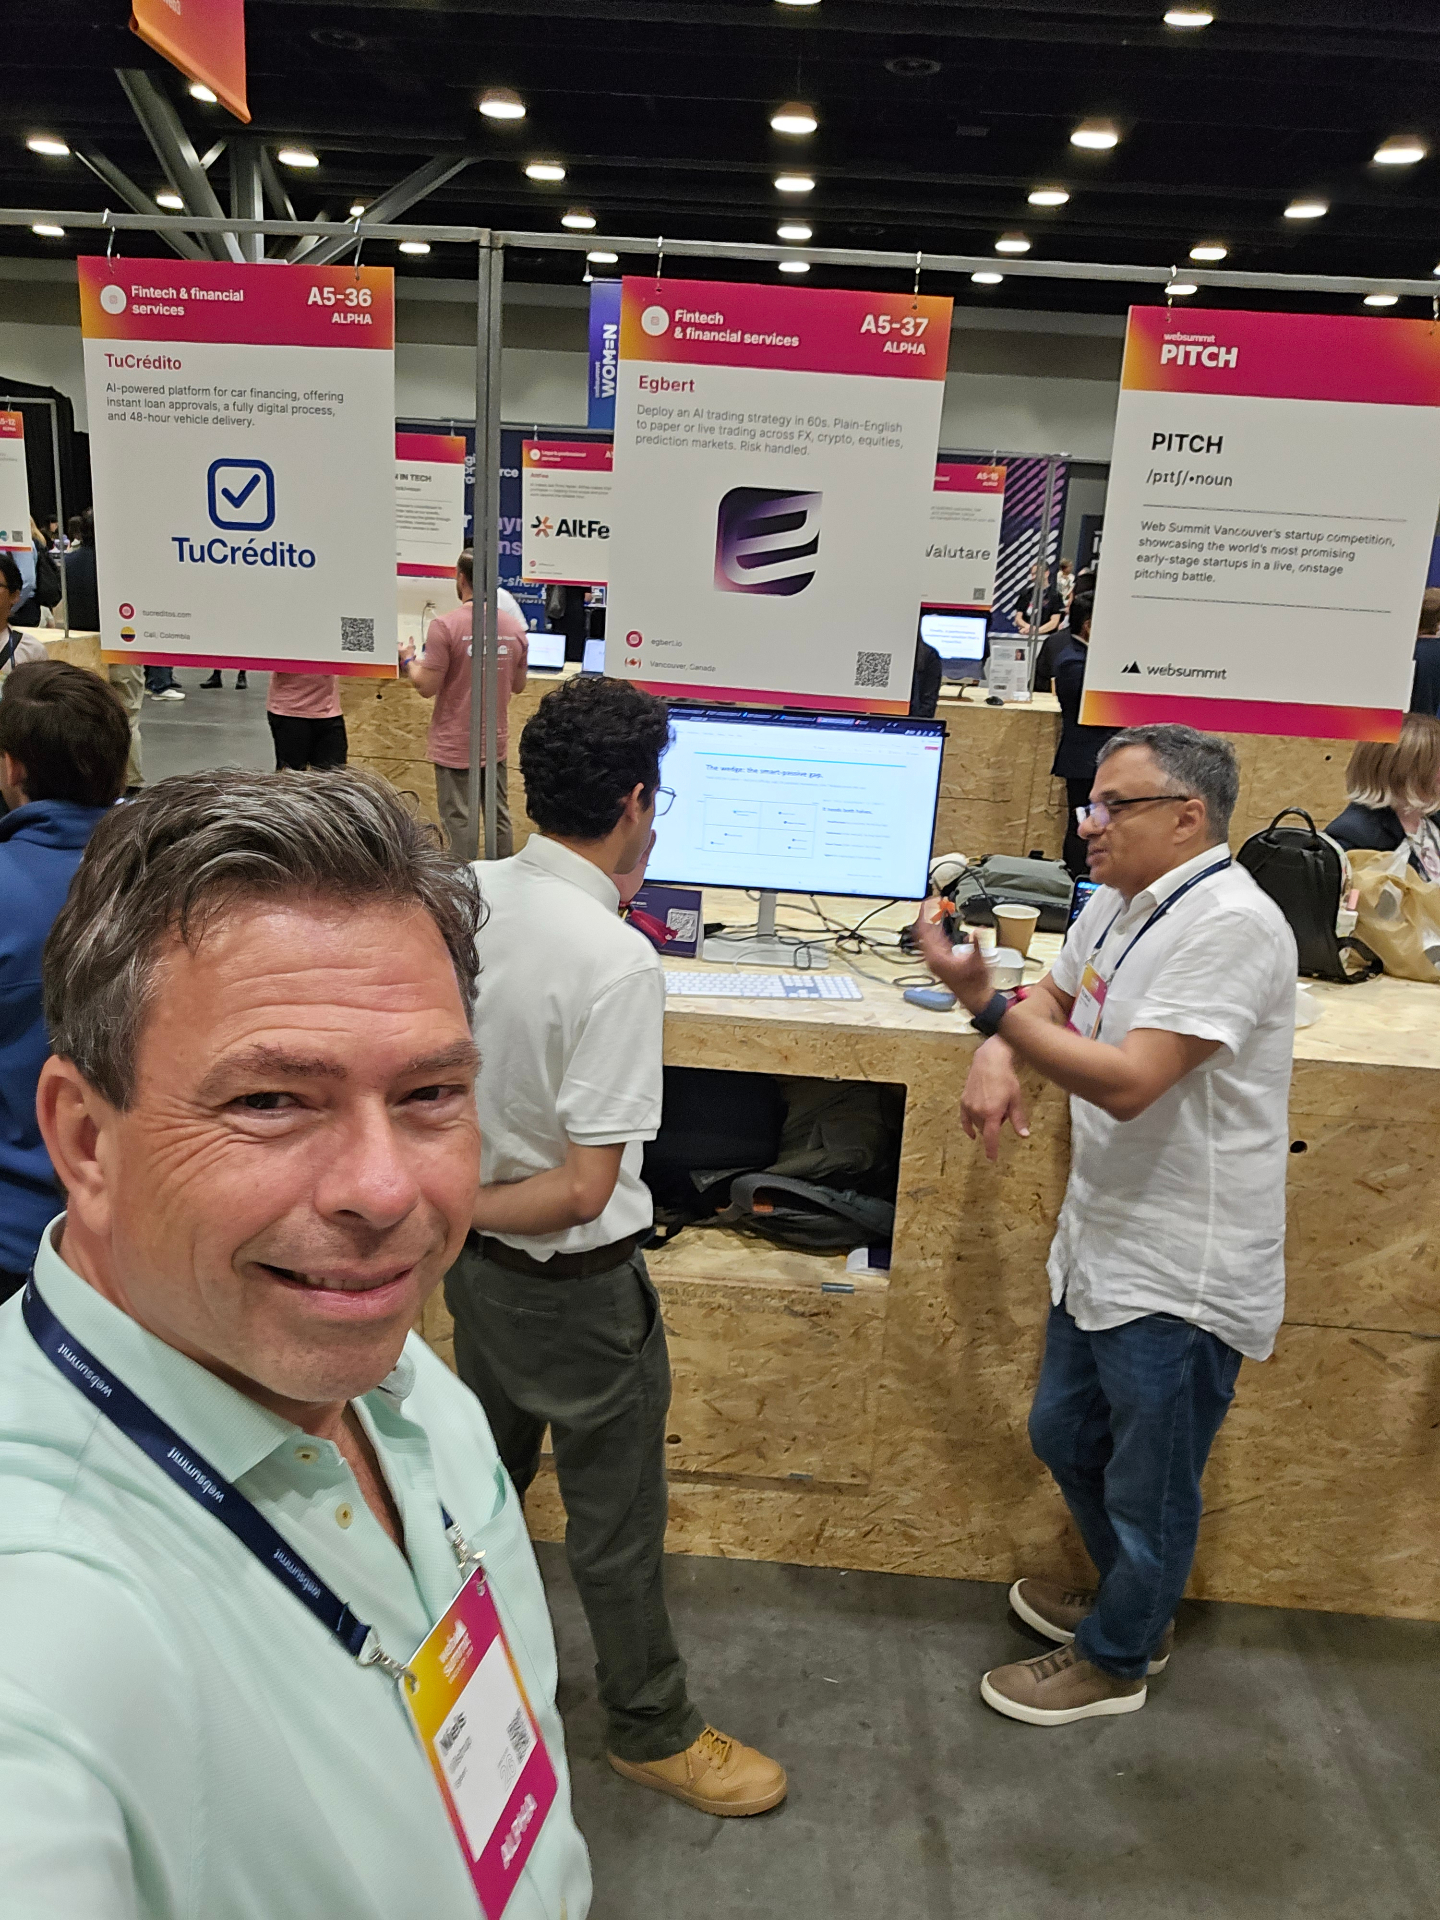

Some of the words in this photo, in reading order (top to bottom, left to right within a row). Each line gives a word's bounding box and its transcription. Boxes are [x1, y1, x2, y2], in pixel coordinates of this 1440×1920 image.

[131, 285, 177, 299] Fintech
[179, 287, 189, 299] &
[190, 287, 244, 302] financial
[307, 286, 372, 307] A5-36
[132, 303, 185, 316] services
[331, 312, 373, 325] ALPHA
[674, 309, 724, 325] Fintech
[860, 314, 930, 338] A5-37
[674, 327, 684, 339] &
[685, 327, 741, 343] financial
[743, 333, 800, 347] services
[1163, 331, 1216, 343] websummit
[883, 341, 927, 355] ALPHA
[1159, 344, 1239, 368] PITCH
[104, 353, 182, 371] TuCrédito
[106, 383, 165, 397] AI-powered
[168, 384, 211, 399] platform
[213, 386, 228, 398] for
[230, 389, 247, 398] car
[250, 387, 300, 402] financing,
[303, 389, 344, 404] offering
[638, 375, 696, 394] Egbert
[107, 397, 142, 409] instant
[144, 398, 166, 409] loan
[168, 399, 219, 413] approvals,
[223, 403, 231, 412] a
[232, 401, 254, 415] fully
[257, 402, 289, 416] digital
[291, 404, 336, 418] process,
[107, 410, 127, 422] and
[129, 411, 171, 423] 48-hour
[173, 413, 209, 425] vehicle
[212, 415, 255, 429] delivery.
[636, 404, 674, 419] Deploy
[677, 408, 690, 418] an
[693, 407, 704, 418] AI
[706, 408, 744, 424] trading
[747, 411, 793, 427] strategy
[795, 414, 805, 425] in
[807, 415, 831, 428] 60s.
[834, 418, 903, 433] Plain-English
[636, 419, 648, 430] to
[650, 421, 681, 435] paper
[683, 424, 695, 433] or
[697, 422, 716, 435] live
[718, 424, 756, 440] trading
[759, 428, 795, 441] across
[797, 429, 815, 443] FX,
[817, 431, 855, 446] crypto,
[858, 434, 904, 449] equities,
[1151, 432, 1224, 455] PITCH
[635, 434, 689, 448] prediction
[692, 437, 737, 450] markets.
[740, 440, 762, 452] Risk
[764, 442, 810, 456] handled.
[410, 474, 432, 483] TECH
[1140, 520, 1166, 533] Web
[1168, 522, 1210, 535] Summit
[1213, 524, 1282, 539] Vancouver's
[1284, 529, 1324, 543] startup
[1326, 532, 1396, 548] competition,
[171, 536, 316, 569] TuCrédito
[1138, 537, 1204, 552] showcasing
[1207, 540, 1225, 551] the
[1228, 541, 1268, 554] world's
[1270, 544, 1298, 556] most
[1300, 546, 1356, 561] promising
[1136, 552, 1200, 567] early-stage
[1202, 557, 1248, 570] startups
[1251, 558, 1261, 569] in
[1263, 561, 1271, 570] a
[1273, 560, 1296, 573] live,
[1298, 562, 1344, 576] onstage
[1134, 568, 1179, 583] pitching
[1181, 570, 1216, 583] battle.
[142, 609, 192, 619] tucreditos.com
[159, 631, 191, 641] Colombia
[650, 660, 688, 672] Vancouver,
[689, 663, 716, 673] Canada
[1147, 663, 1228, 680] websummit
[57, 1342, 113, 1398] websummit
[167, 1446, 225, 1503] websummit
[273, 1547, 321, 1599] websummit
